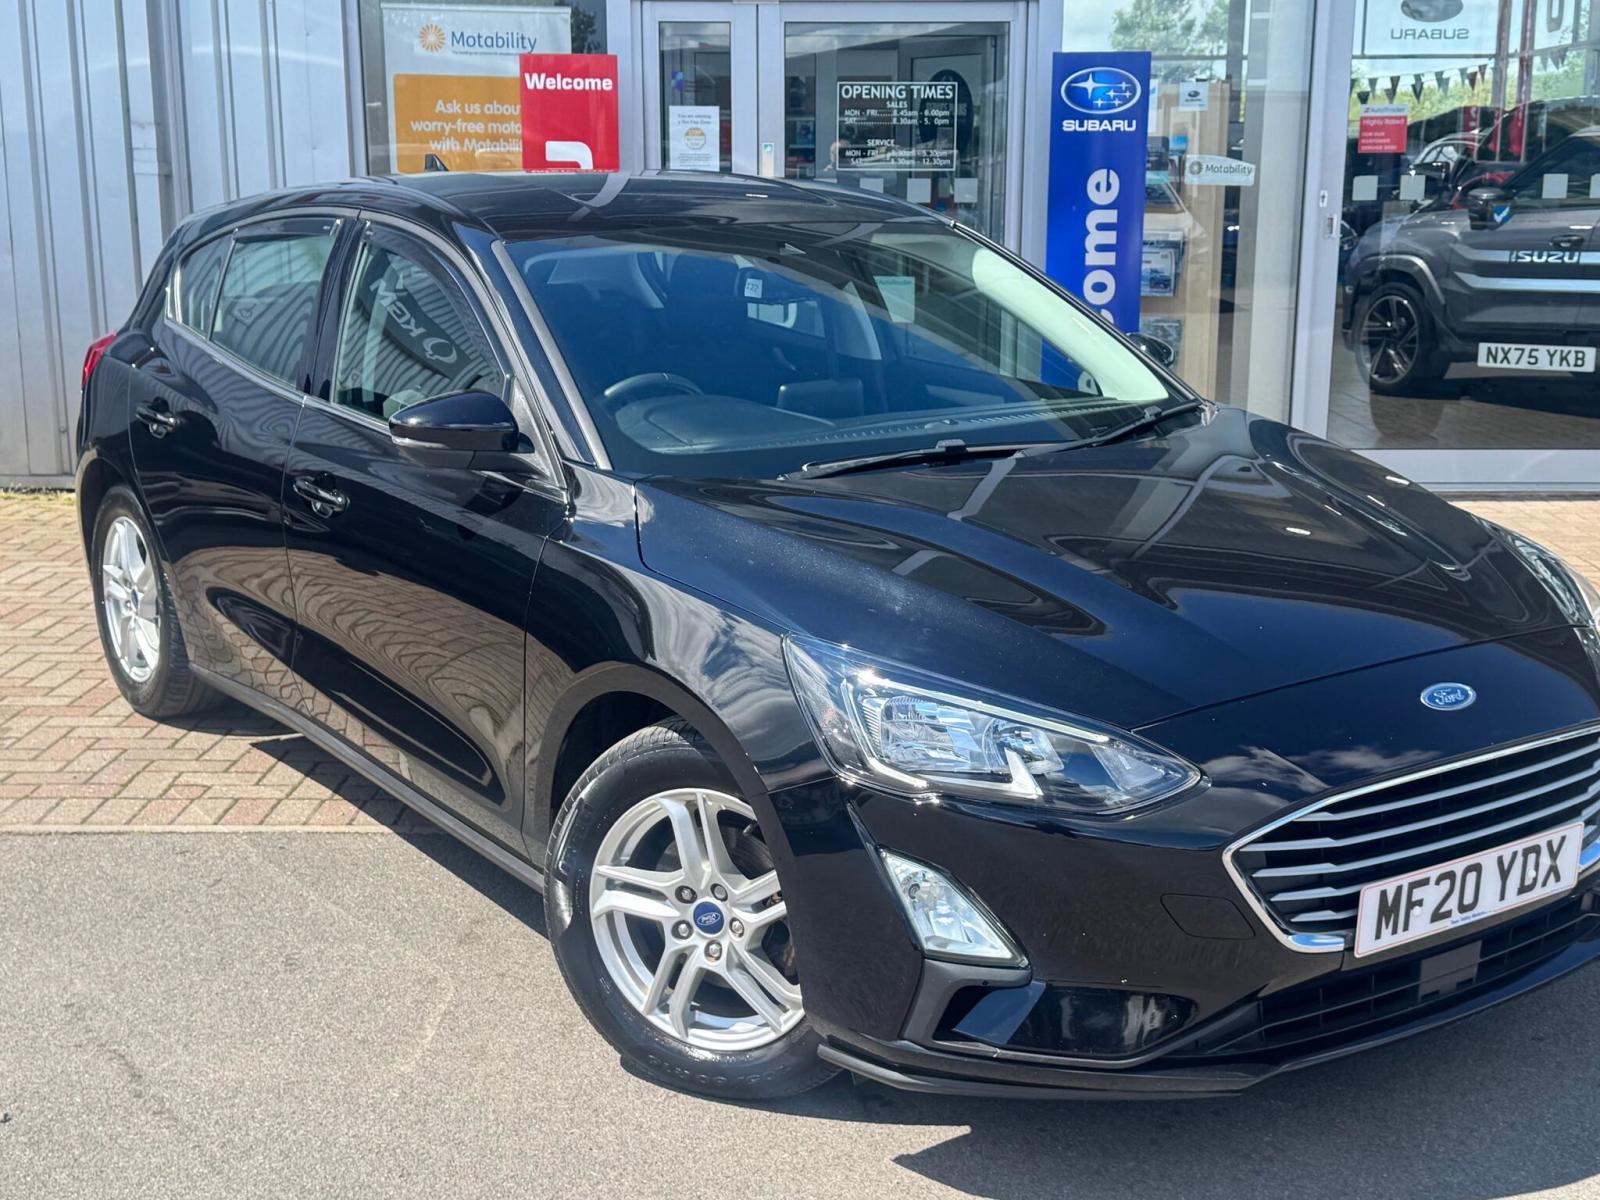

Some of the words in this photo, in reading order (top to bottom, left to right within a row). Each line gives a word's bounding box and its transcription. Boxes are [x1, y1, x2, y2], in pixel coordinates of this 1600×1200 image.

[451, 30, 537, 53] Motability
[524, 72, 613, 91] Welcome
[841, 85, 906, 99] OPENING
[911, 85, 953, 99] TIMES
[435, 99, 461, 114] Ask
[464, 103, 481, 115] us
[484, 99, 521, 115] abou
[410, 118, 485, 136] worry-free
[488, 120, 522, 134] moto
[1062, 119, 1137, 132] SUBARU
[430, 136, 460, 152] with
[1205, 164, 1253, 176] Motability
[1511, 250, 1579, 263] ISUZU
[1486, 346, 1540, 366] NX75
[1546, 348, 1587, 368] YKB
[1432, 687, 1466, 705] Ford
[1374, 861, 1483, 941] MF20
[1496, 834, 1567, 902] YDX
